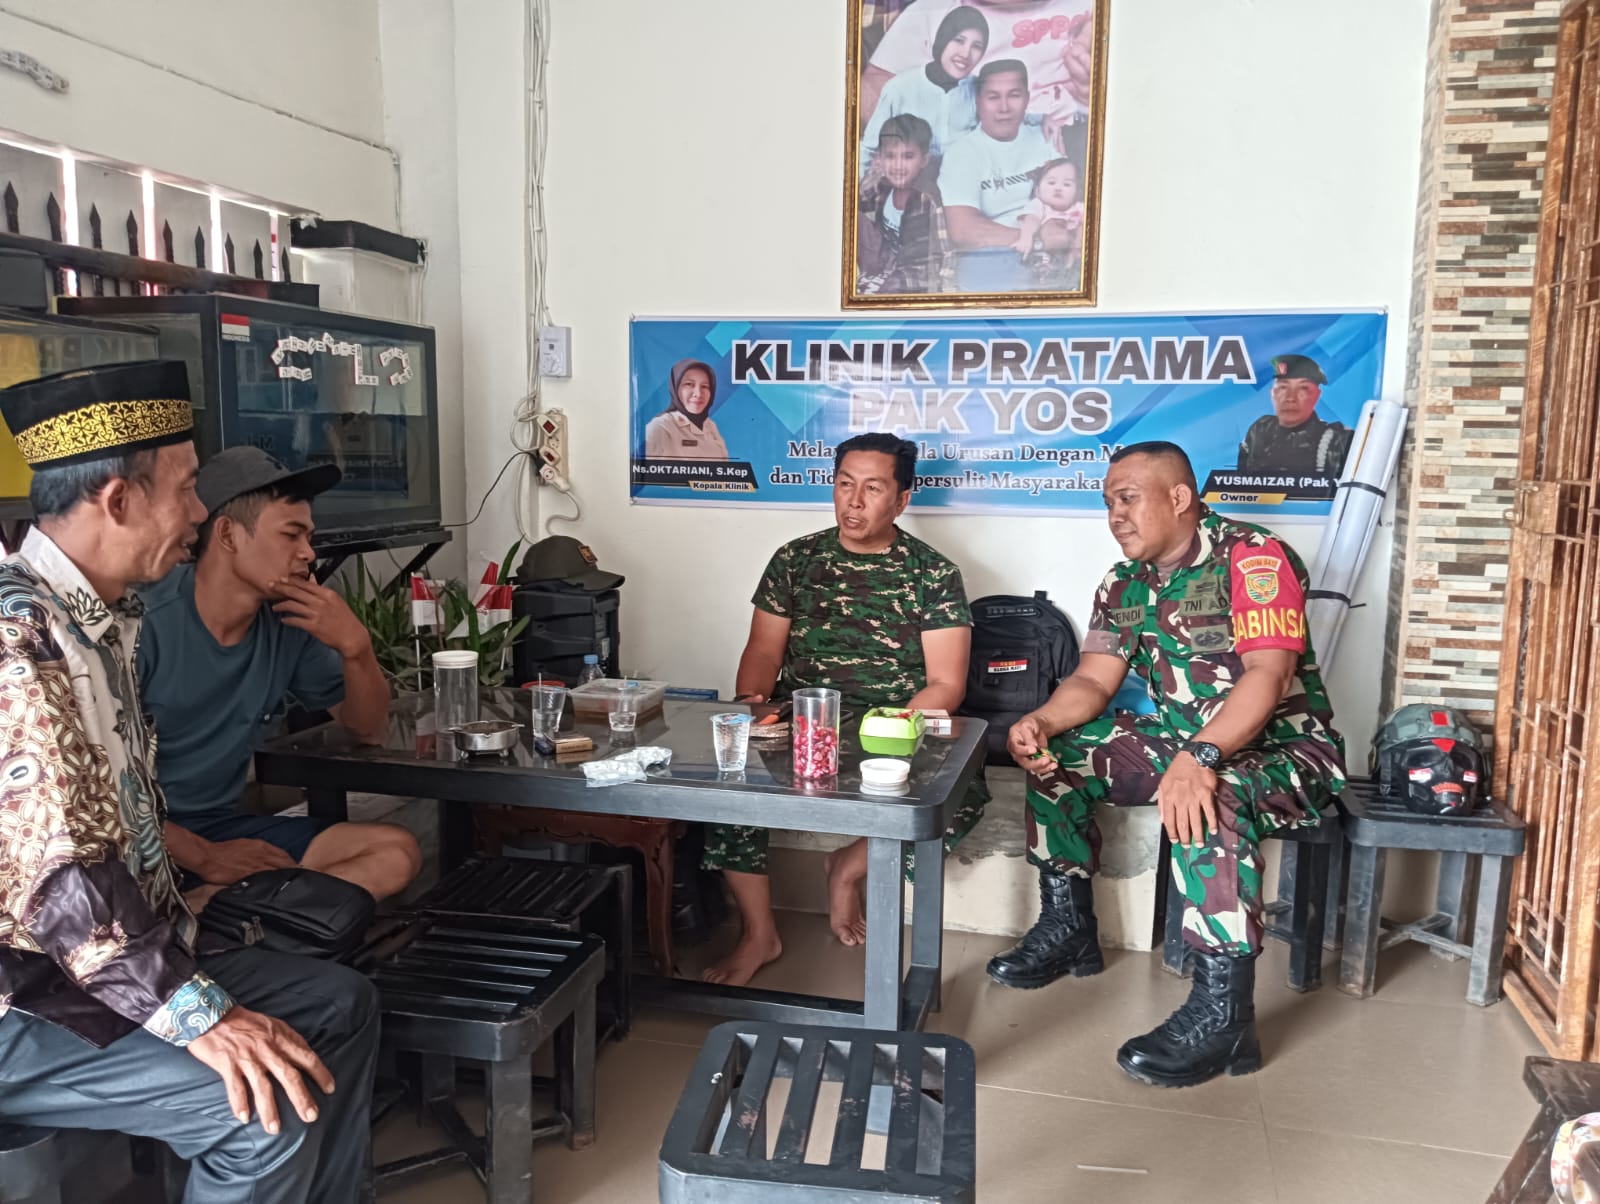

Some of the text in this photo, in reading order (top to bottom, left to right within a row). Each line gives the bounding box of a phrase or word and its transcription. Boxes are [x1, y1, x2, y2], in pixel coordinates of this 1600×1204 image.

[733, 337, 1255, 383] KLINIK PRATAMA
[850, 388, 1111, 435] PAK YOS
[943, 443, 1014, 460] Urusan
[1020, 444, 1095, 466] Dengan
[716, 467, 748, 478] S.Kep
[725, 482, 750, 490] Klinik
[770, 467, 803, 484] dan
[990, 472, 1104, 494] Masyaraka
[1214, 475, 1295, 487] YUSMAIZAR
[1298, 477, 1330, 488] (Pak
[1220, 493, 1258, 502] Owner
[1184, 600, 1203, 612] TNI
